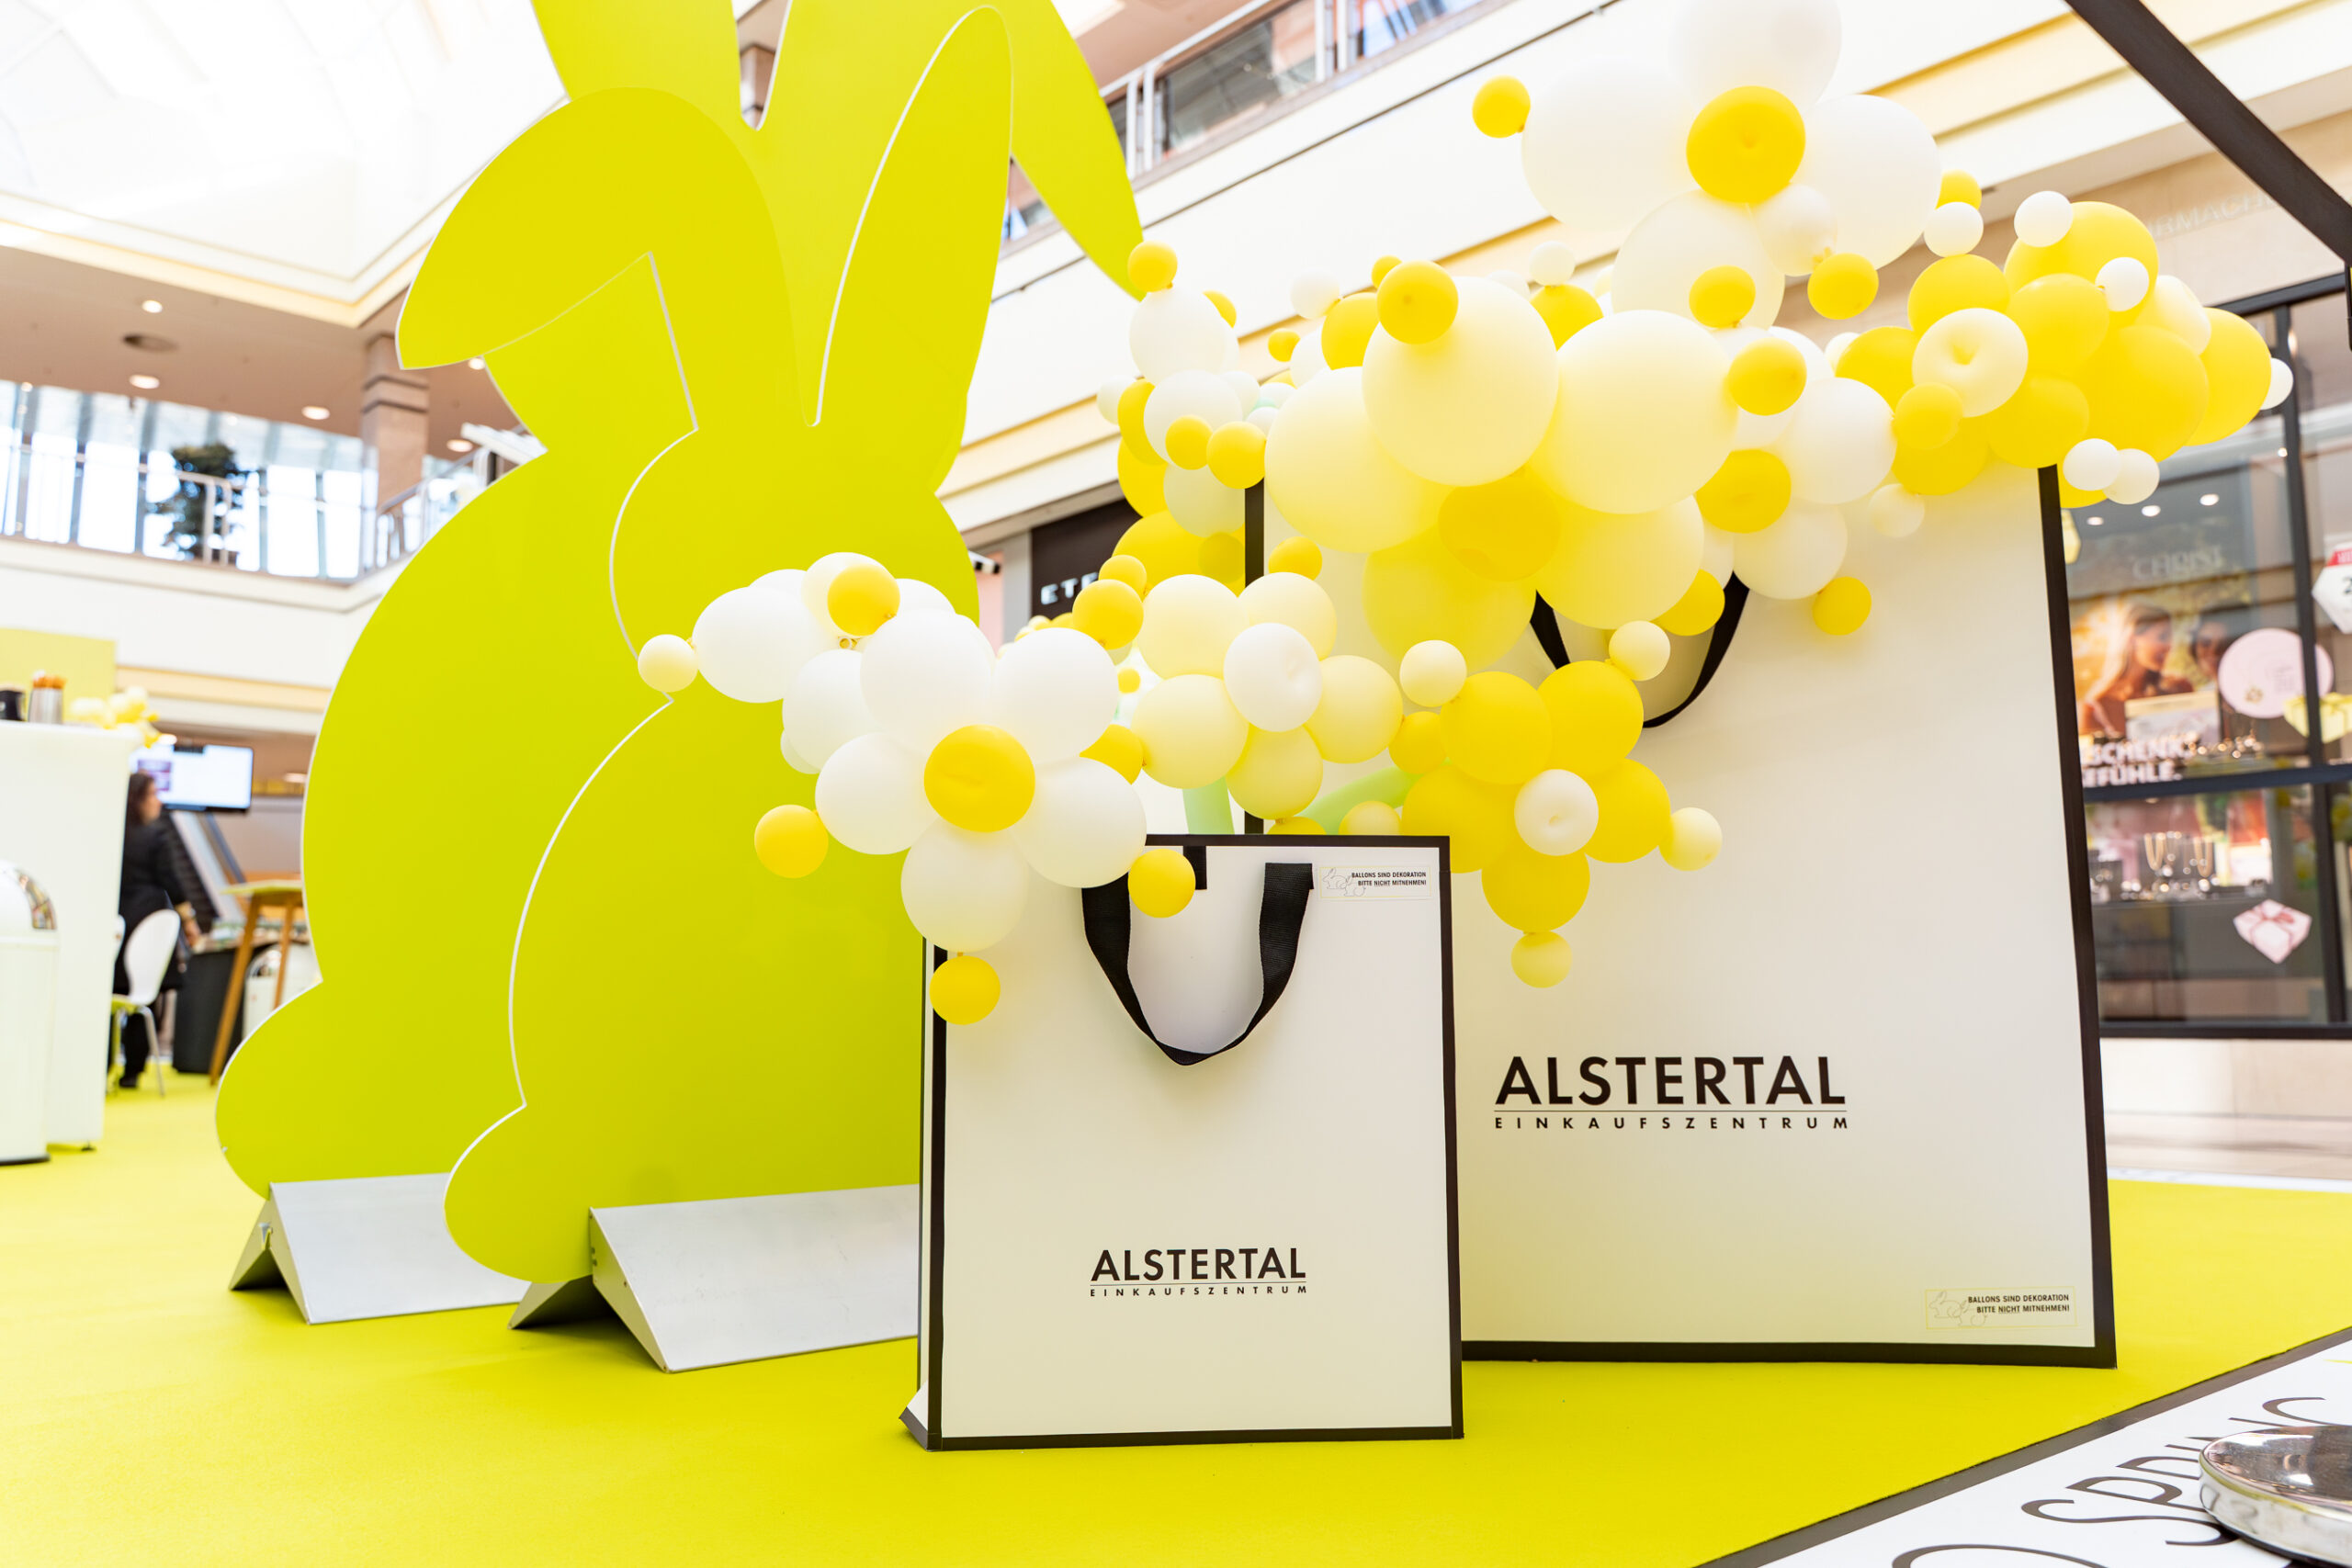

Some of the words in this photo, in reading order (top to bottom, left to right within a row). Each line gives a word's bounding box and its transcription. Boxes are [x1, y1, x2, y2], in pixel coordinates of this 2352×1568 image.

[1495, 1055, 1846, 1105] ALSTERTAL
[1494, 1117, 1849, 1130] EINKAUFSZENTRUM
[1091, 1247, 1306, 1281] ALSTERTAL
[1090, 1286, 1306, 1297] EINKAUFSZENTRUM
[1968, 1295, 2001, 1303] BALLONS
[2023, 1293, 2069, 1302] DEKORATION
[1976, 1305, 1996, 1314] BITTE
[1998, 1305, 2020, 1314] NICHT
[2023, 1303, 2070, 1312] MITNEHMEN!
